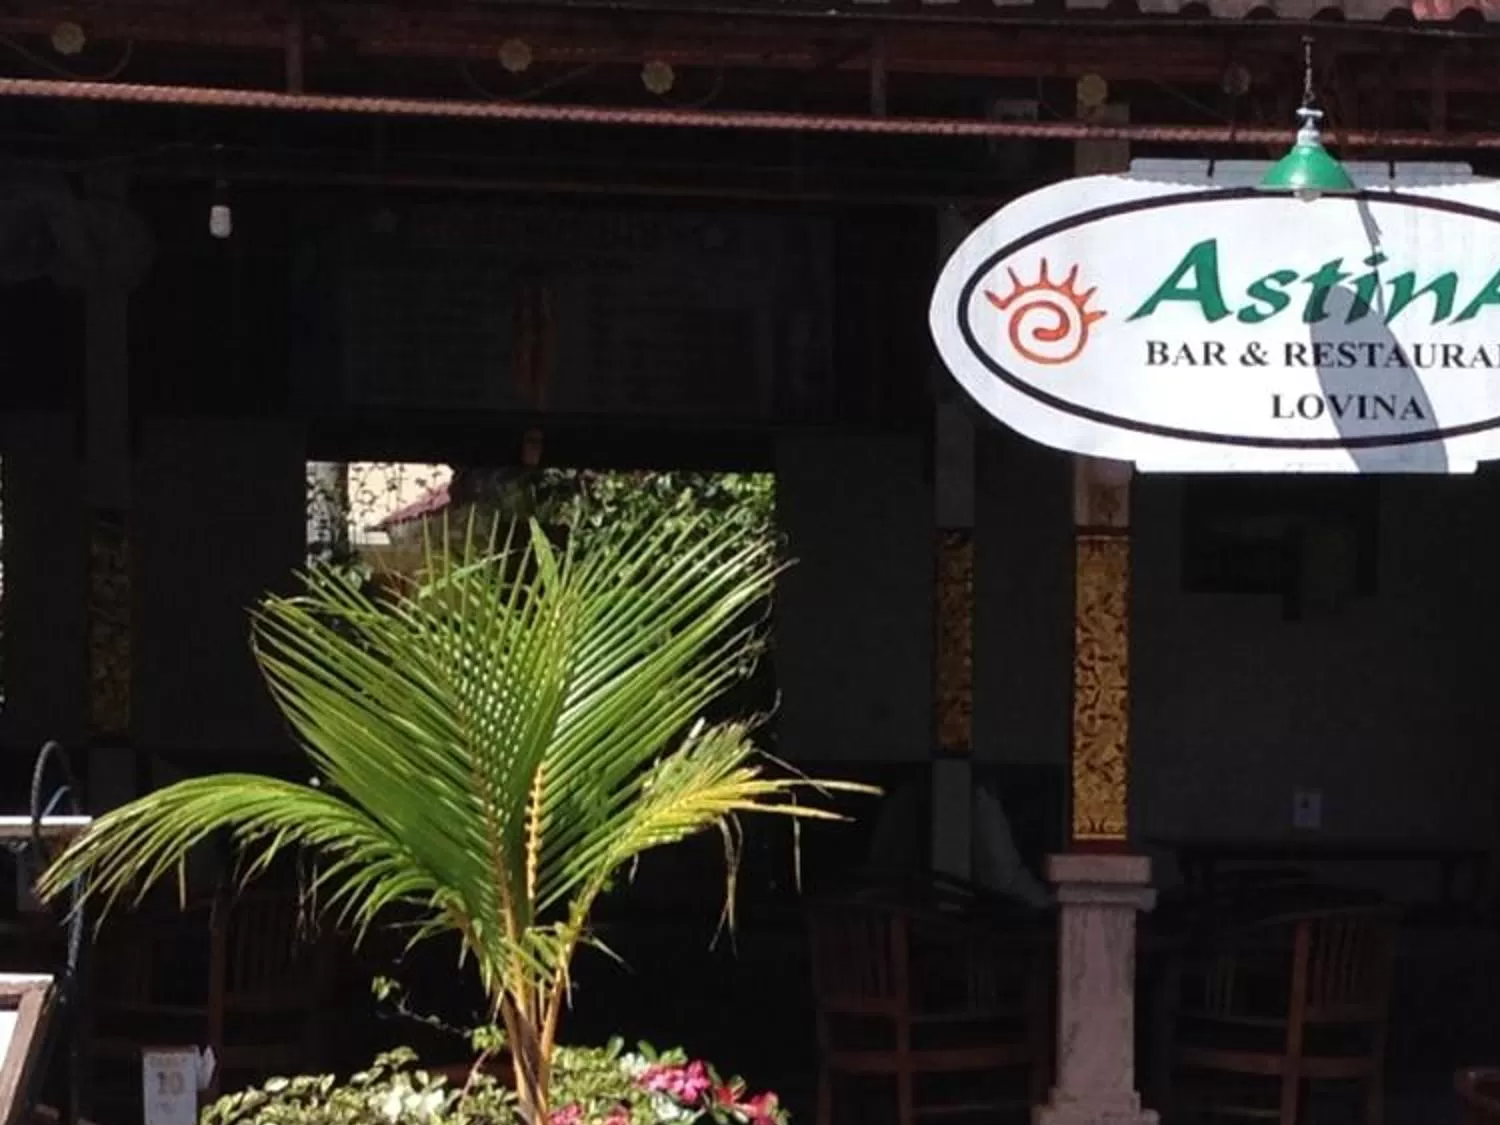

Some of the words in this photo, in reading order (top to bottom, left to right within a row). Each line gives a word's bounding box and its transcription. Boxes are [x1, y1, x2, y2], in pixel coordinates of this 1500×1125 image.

[1145, 340, 1228, 367] BAR
[1241, 341, 1269, 367] &
[1271, 393, 1425, 420] LOVINA
